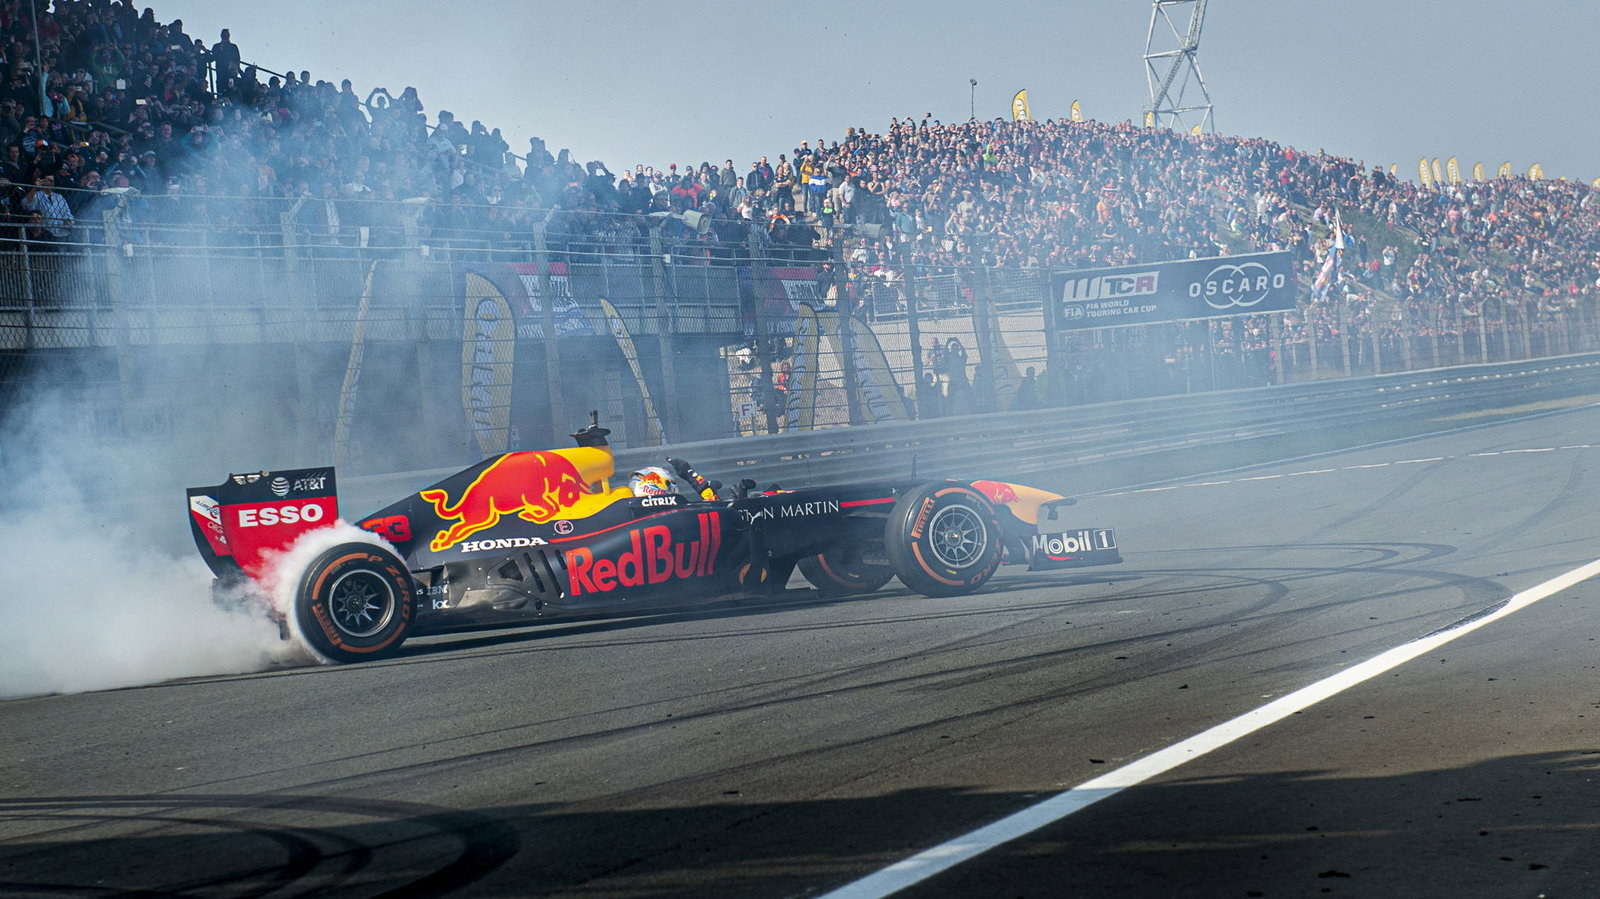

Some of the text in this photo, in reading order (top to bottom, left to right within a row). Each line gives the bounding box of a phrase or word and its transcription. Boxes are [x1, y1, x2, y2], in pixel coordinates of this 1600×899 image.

[1189, 273, 1285, 298] OSCARO
[1086, 299, 1130, 310] FIA WORLD
[1086, 305, 1157, 318] TOURING CAR CUP
[293, 477, 327, 491] AT&T
[238, 504, 323, 528] ESSO
[781, 499, 840, 518] MARTIN
[461, 537, 549, 553] HONDA
[1032, 530, 1092, 556] Mobil
